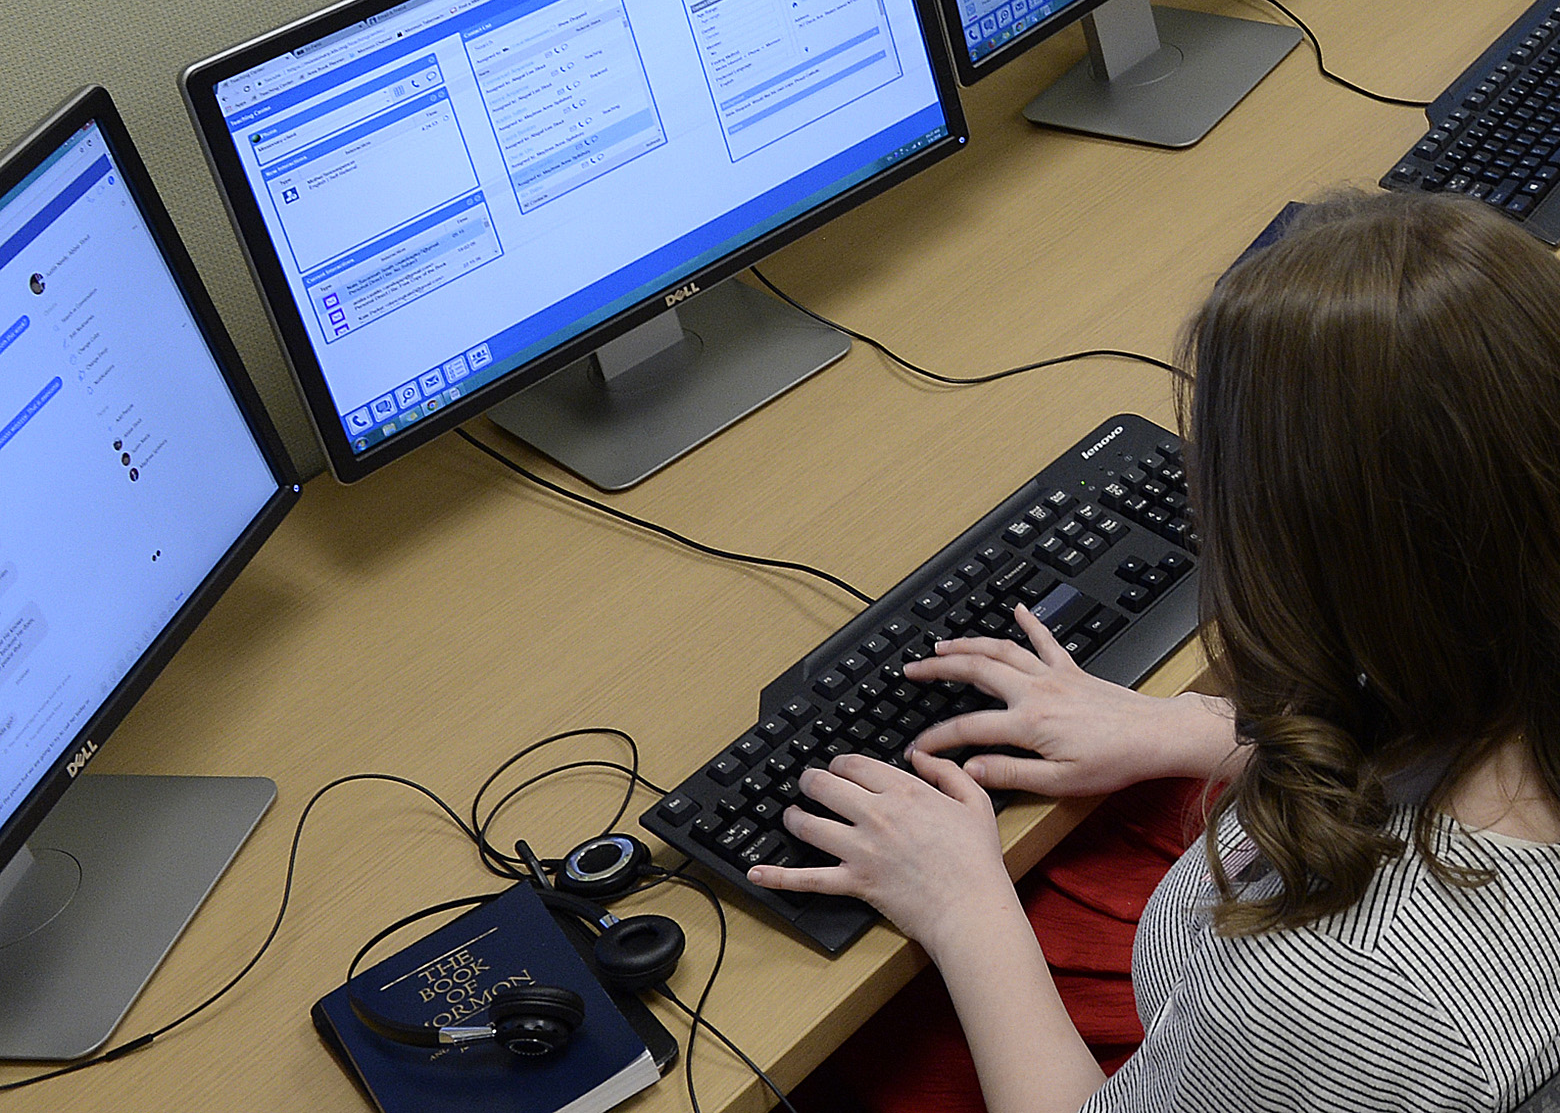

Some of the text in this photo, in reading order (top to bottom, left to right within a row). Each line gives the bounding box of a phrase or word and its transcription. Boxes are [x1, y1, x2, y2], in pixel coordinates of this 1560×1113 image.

[230, 105, 271, 127] Teaching Center
[664, 284, 701, 310] DELL
[1081, 426, 1124, 460] lenovo
[873, 706, 882, 714] Y
[900, 716, 911, 724] H
[66, 739, 98, 778] DELL
[827, 745, 838, 753] R
[779, 781, 792, 791] W
[754, 836, 766, 847] Lock
[418, 950, 474, 984] THE
[418, 958, 490, 1002] BOOK
[446, 979, 478, 1004] OF
[424, 969, 536, 1027] ORMON
